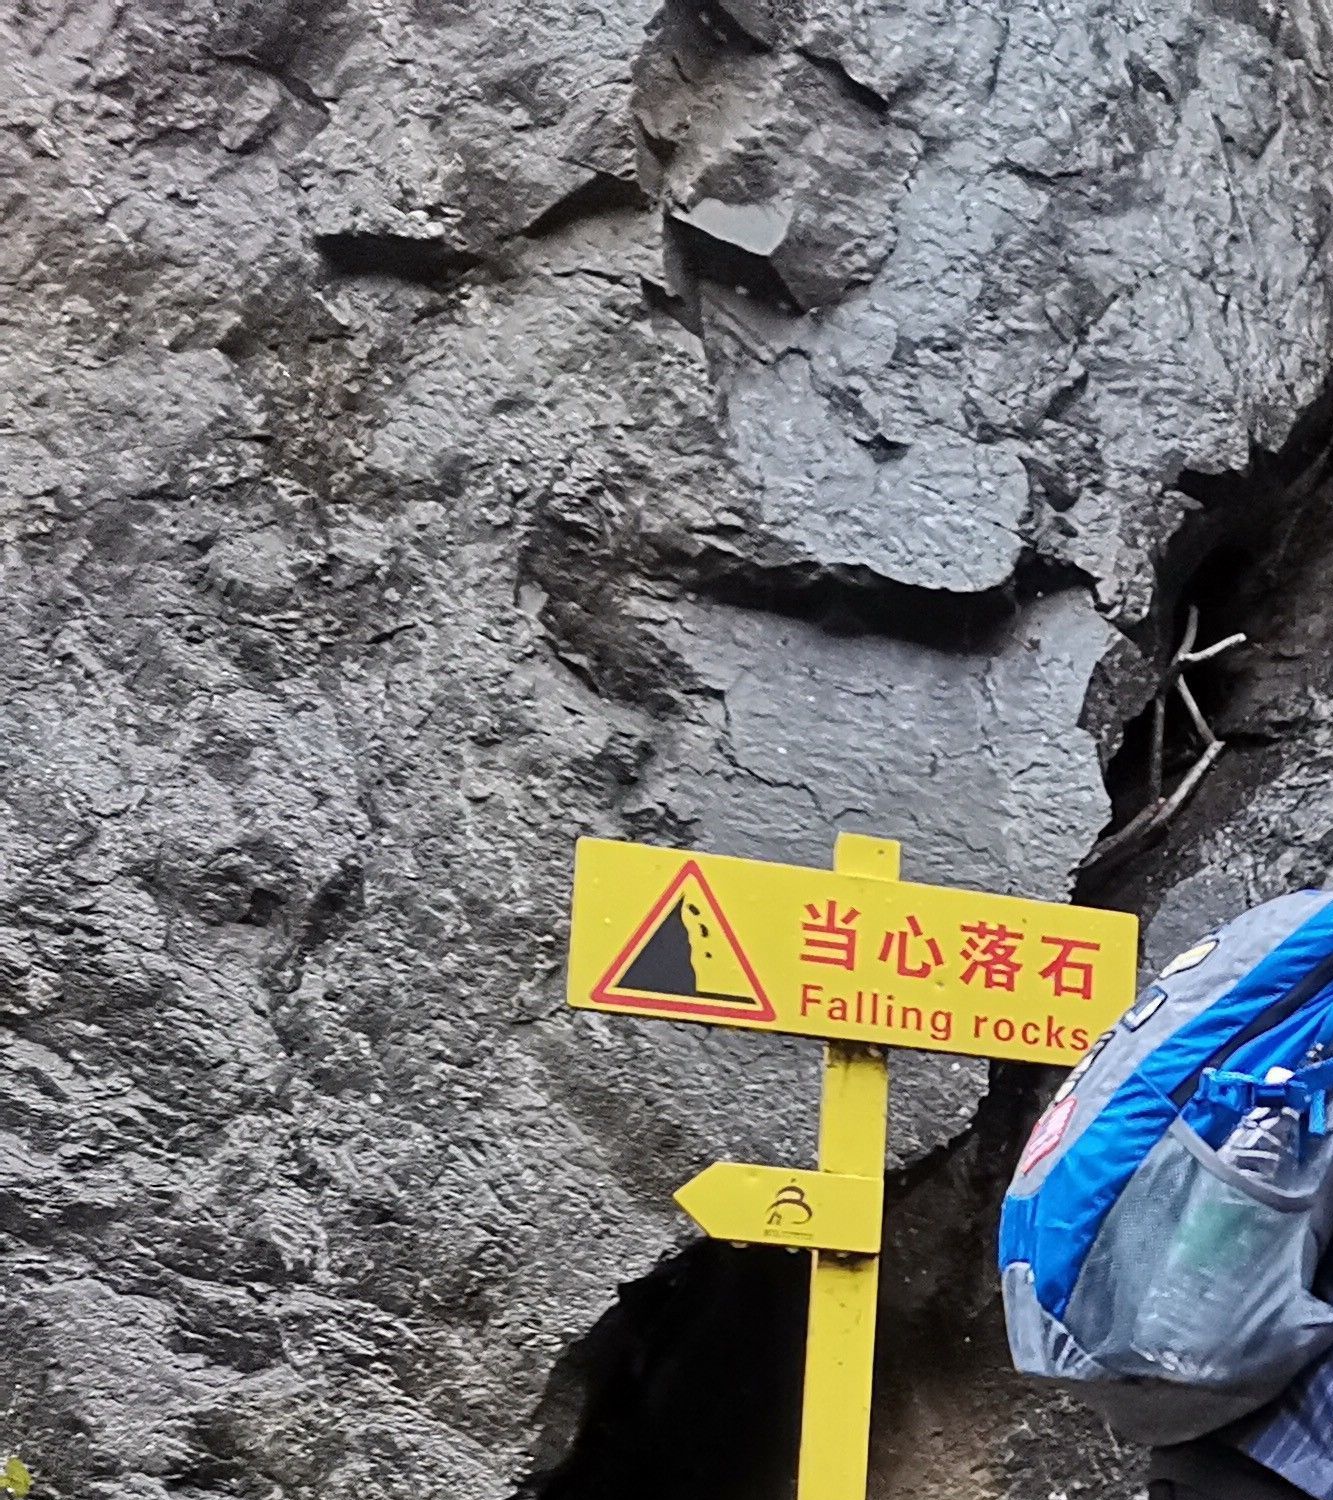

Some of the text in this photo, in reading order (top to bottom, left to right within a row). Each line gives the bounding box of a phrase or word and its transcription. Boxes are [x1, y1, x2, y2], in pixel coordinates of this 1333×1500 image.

[799, 898, 1101, 1002] 当心落石
[800, 983, 1090, 1053] Falling rocks
